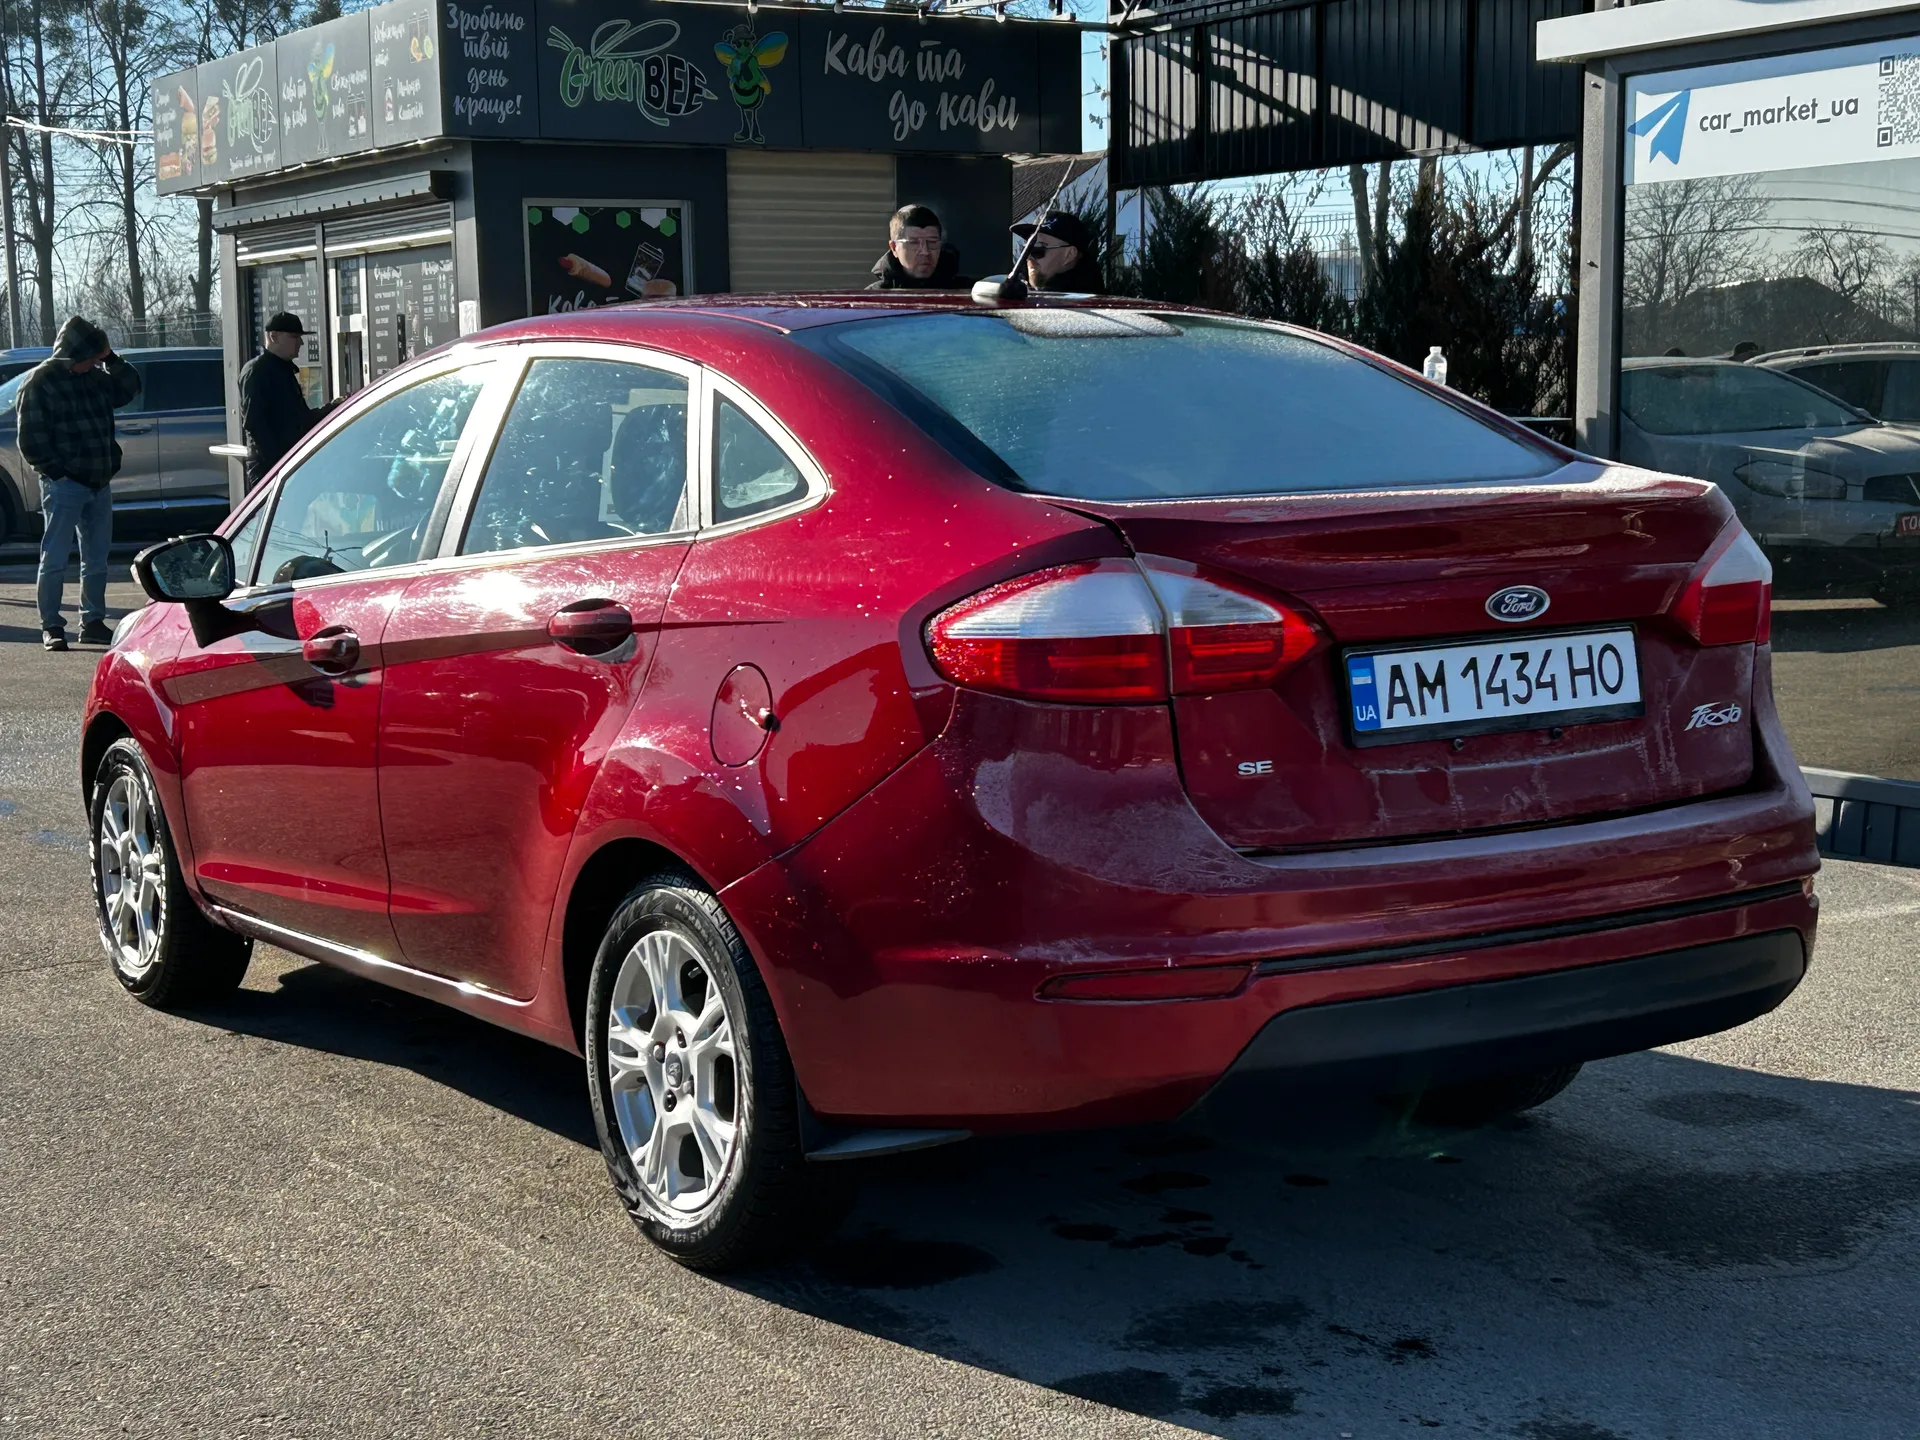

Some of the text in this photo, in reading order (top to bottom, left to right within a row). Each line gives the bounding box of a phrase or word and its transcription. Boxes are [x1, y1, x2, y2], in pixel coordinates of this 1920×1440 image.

[446, 3, 525, 38] Зробимо
[463, 32, 510, 60] твій
[824, 26, 966, 83] Кава та
[467, 66, 509, 94] день
[453, 94, 523, 127] краще!
[888, 78, 1019, 142] до кави
[1699, 96, 1859, 133] car_market_ua
[1500, 592, 1538, 615] Ford
[1386, 642, 1624, 720] AM 1434 HO
[1356, 704, 1378, 722] UA
[1684, 702, 1742, 731] Fiesta
[1237, 760, 1275, 776] SE
